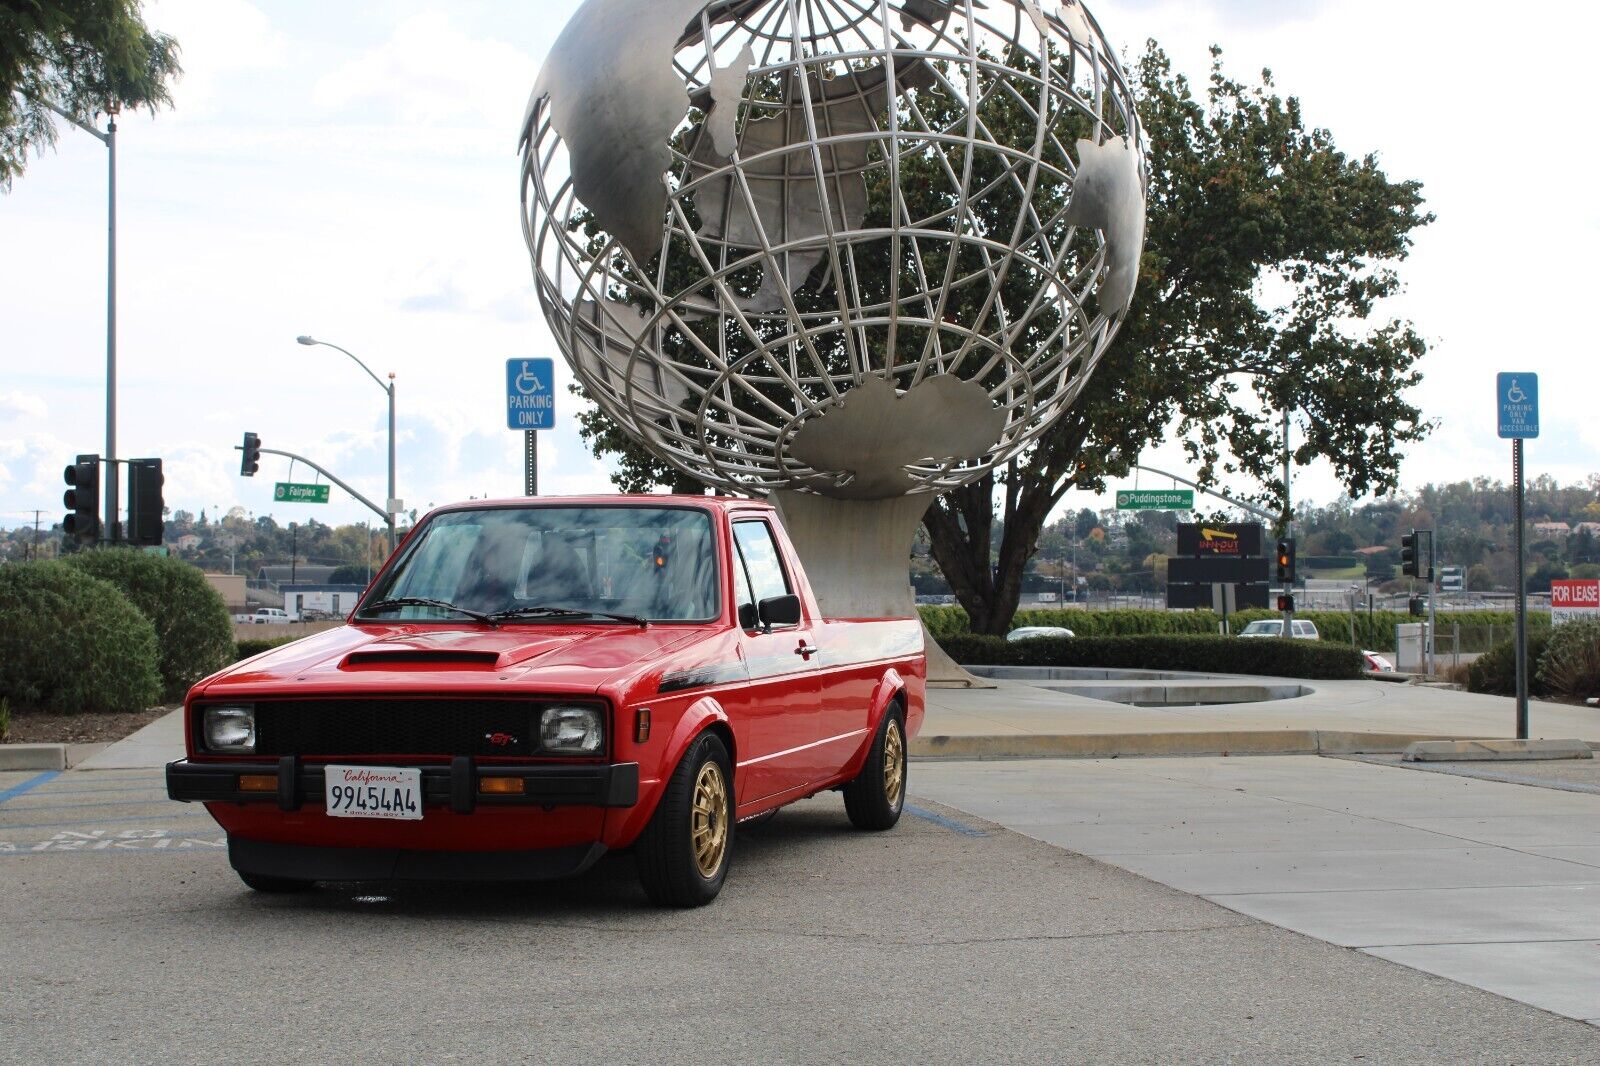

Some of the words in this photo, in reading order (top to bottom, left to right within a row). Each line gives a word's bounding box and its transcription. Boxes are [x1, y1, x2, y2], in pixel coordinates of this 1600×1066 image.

[509, 395, 552, 408] PARKING
[519, 411, 543, 424] ONLY
[289, 486, 316, 499] Fairplex
[1129, 493, 1182, 505] Puddingstone
[1552, 585, 1570, 602] FOR
[1572, 585, 1598, 602] LEASE
[344, 769, 402, 785] California
[331, 785, 416, 812] 99454A4
